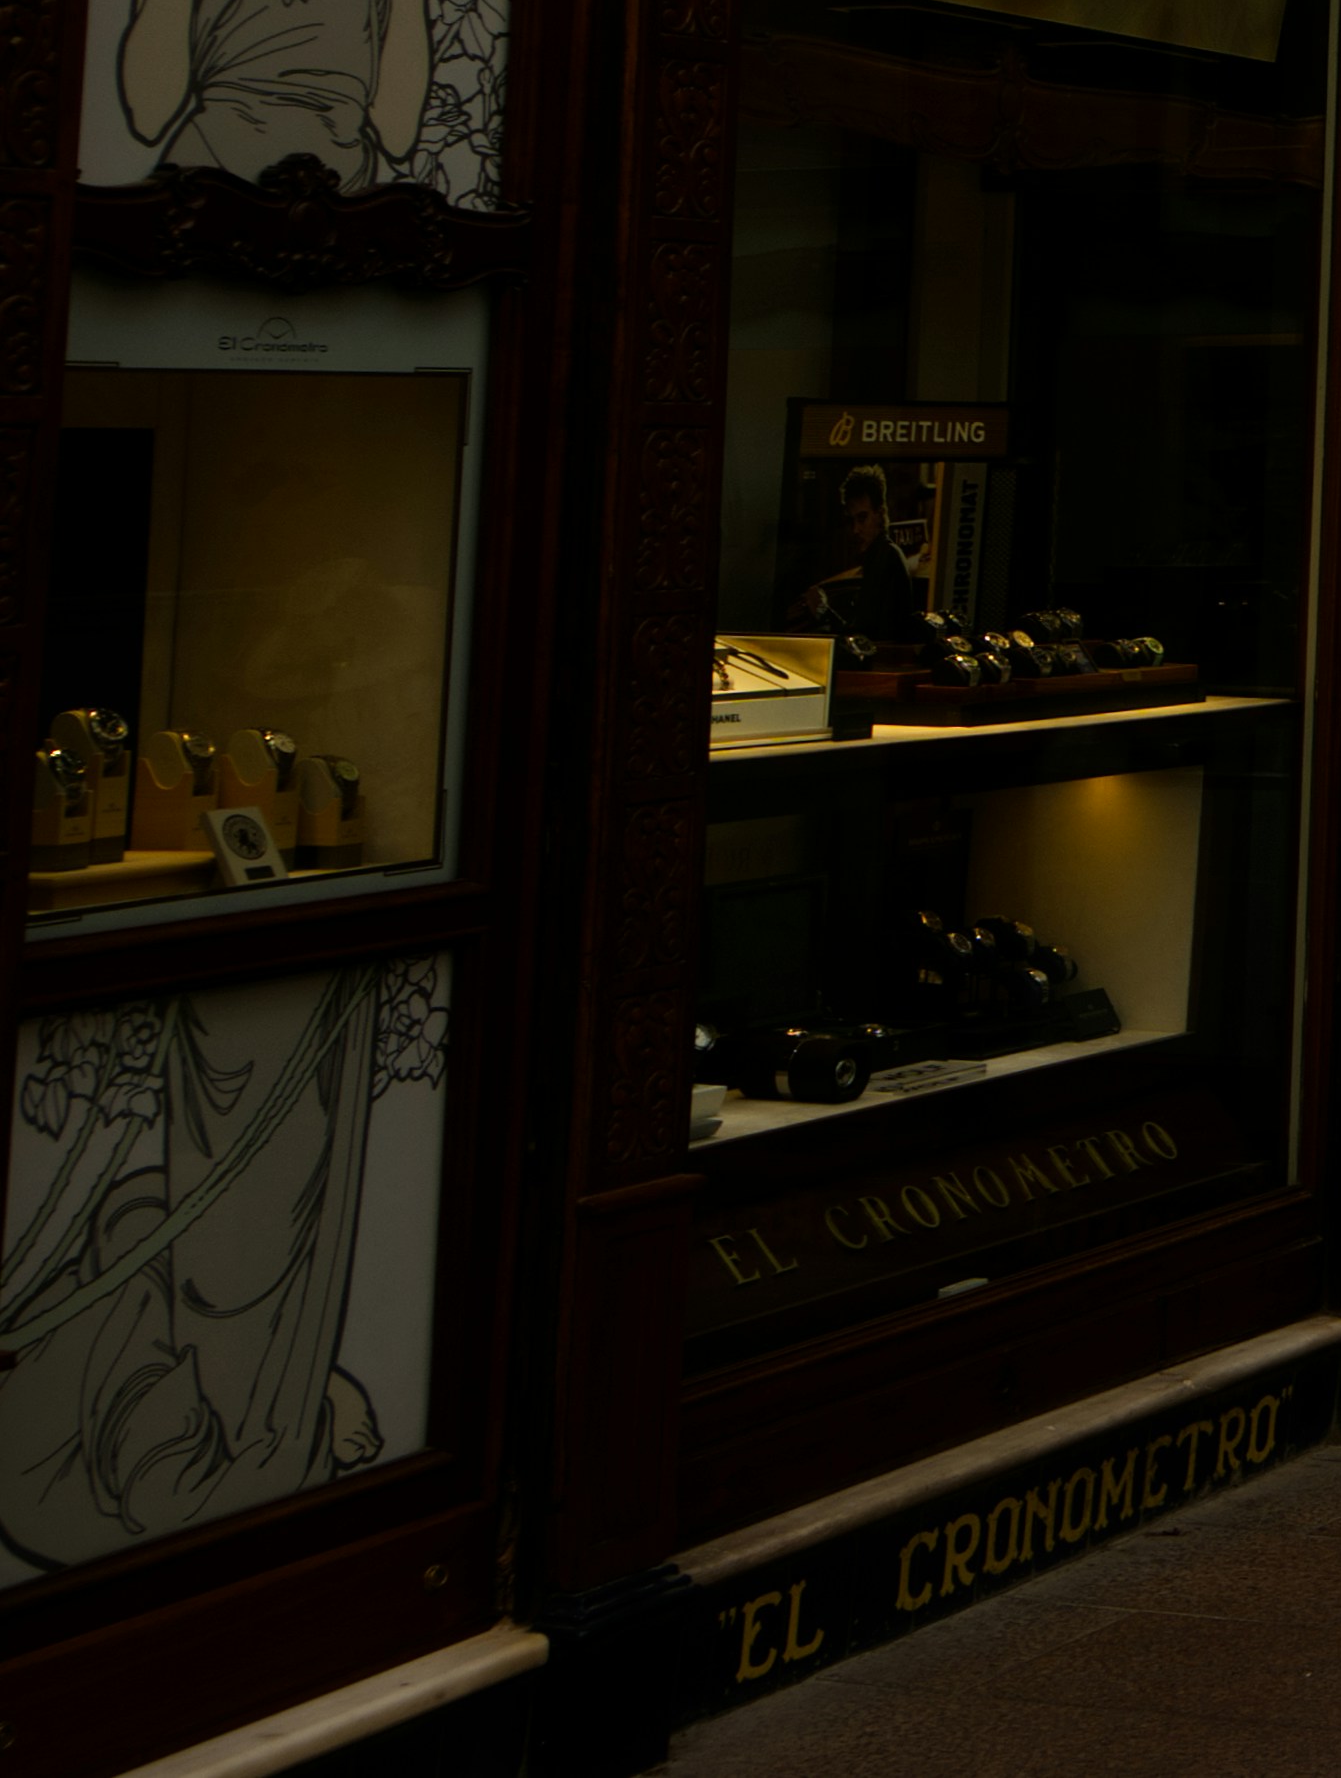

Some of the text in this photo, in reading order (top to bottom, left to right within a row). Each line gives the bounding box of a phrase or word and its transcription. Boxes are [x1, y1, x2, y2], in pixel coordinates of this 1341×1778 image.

[861, 420, 986, 443] BREITLING
[952, 480, 979, 612] HRONOMAT
[711, 713, 741, 724] HANEL
[707, 1119, 1180, 1287] EL CRONOMETRO
